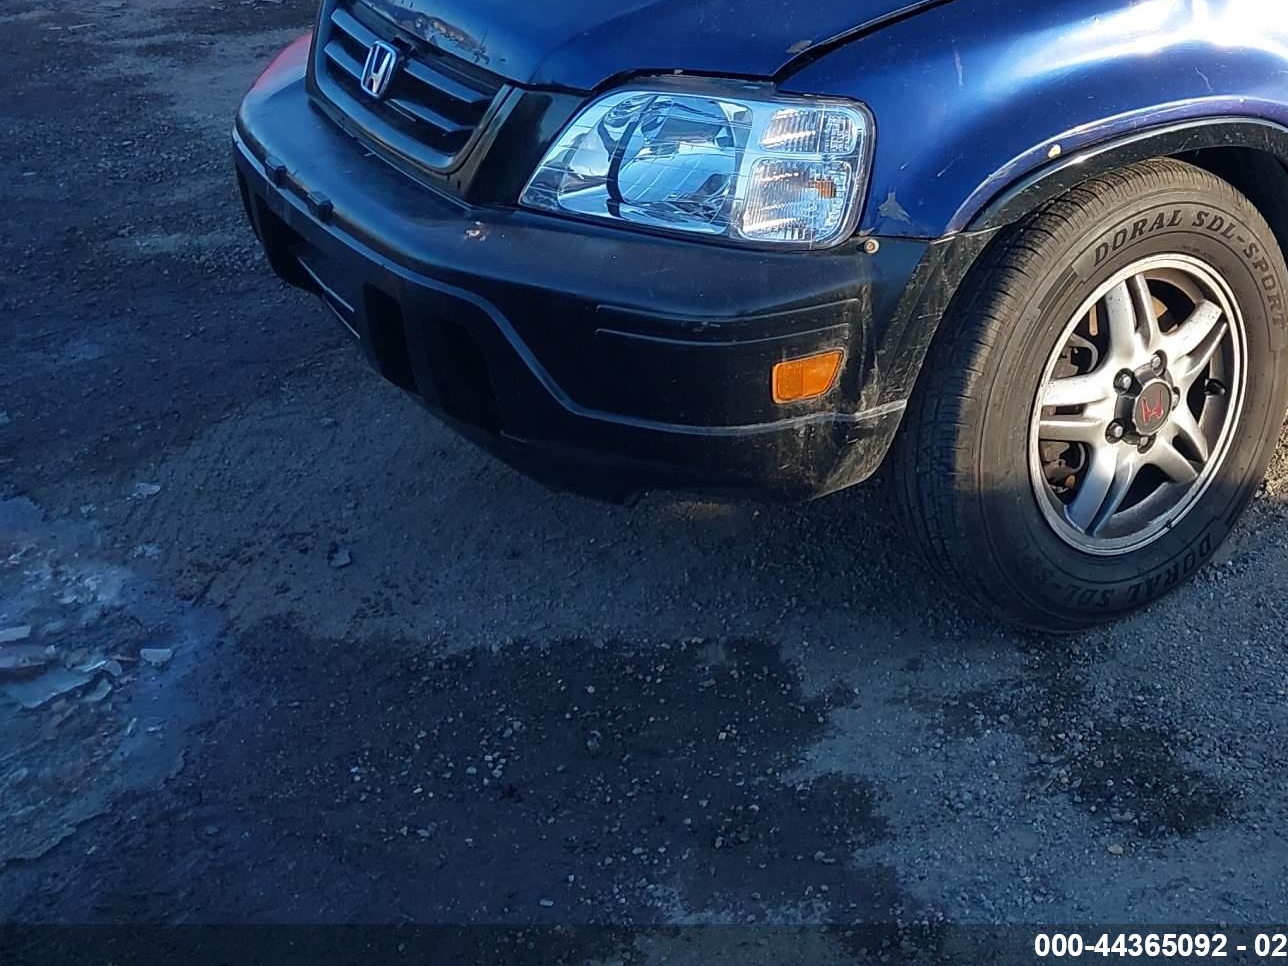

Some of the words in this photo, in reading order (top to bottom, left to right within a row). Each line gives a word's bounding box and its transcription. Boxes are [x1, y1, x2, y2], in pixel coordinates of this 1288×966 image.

[1093, 209, 1183, 267] DORAL
[1192, 210, 1286, 330] SDL-SPORT
[1127, 533, 1212, 598] DORAL
